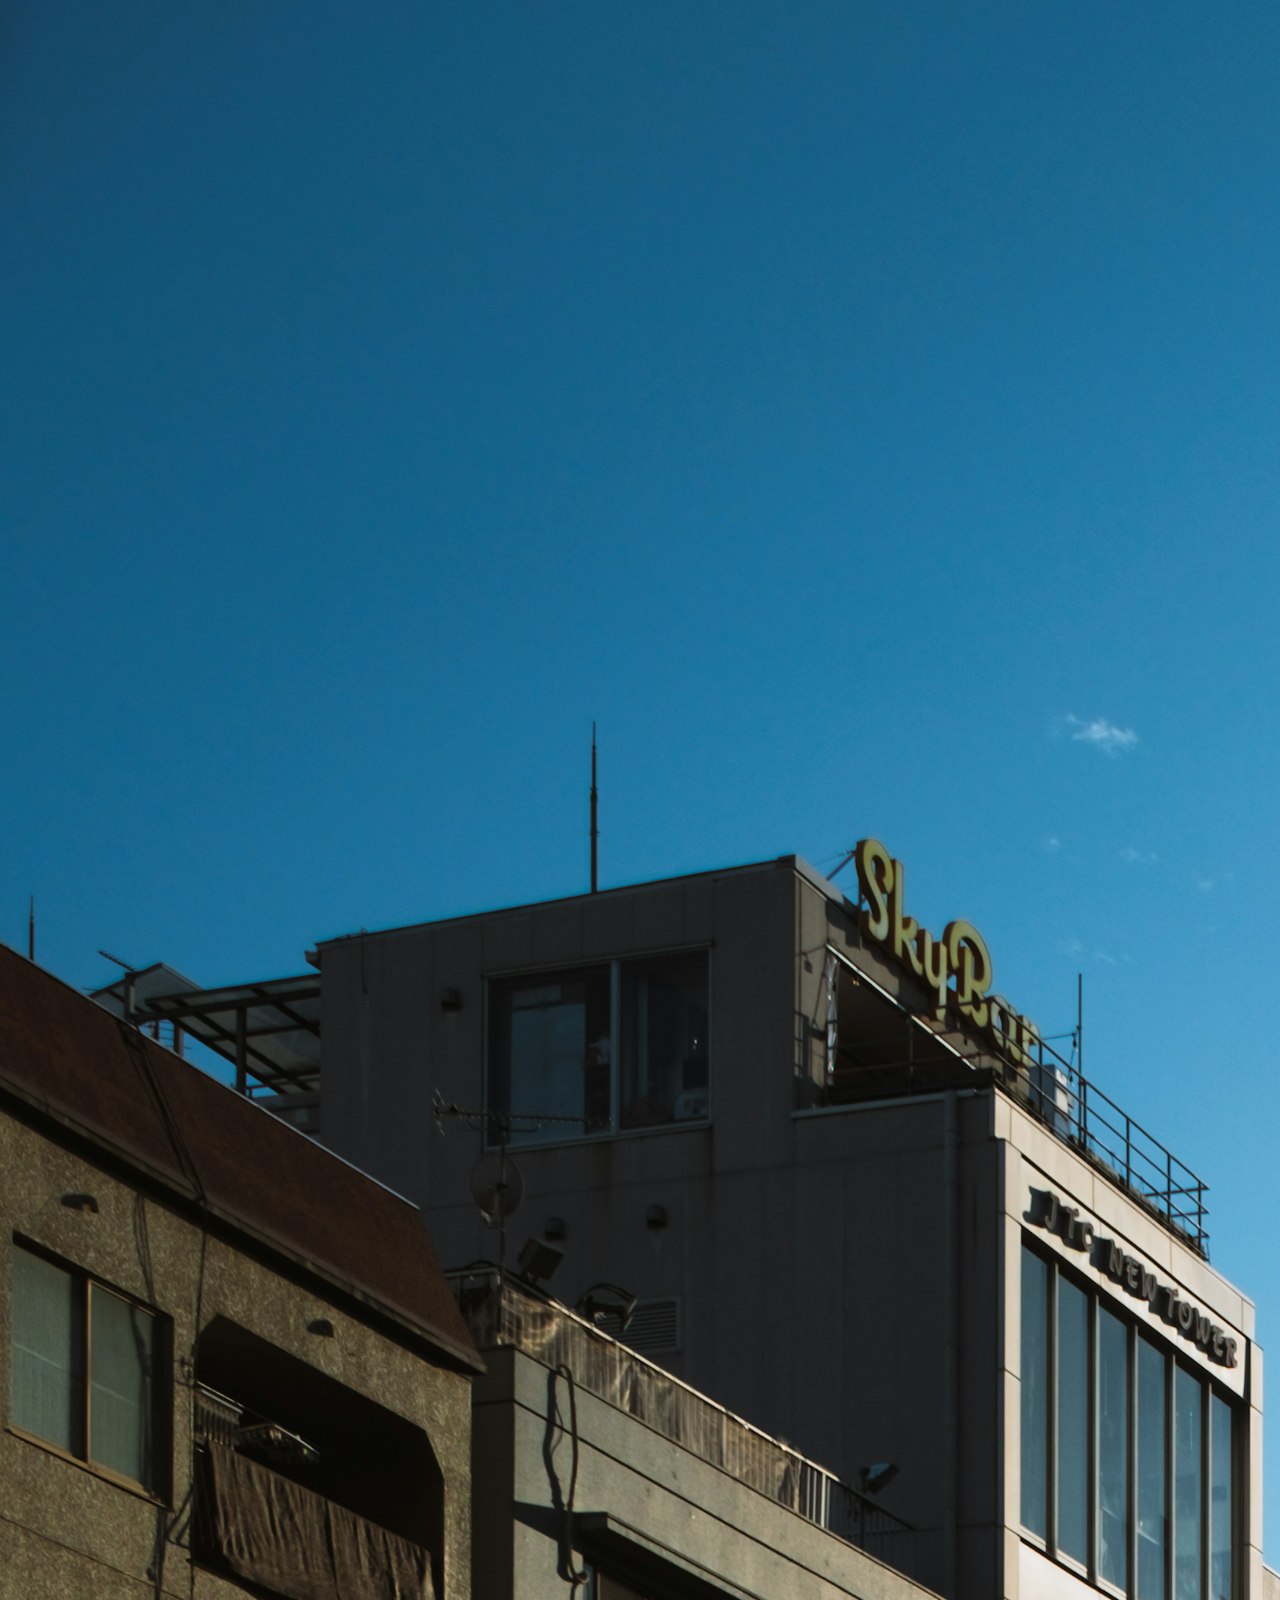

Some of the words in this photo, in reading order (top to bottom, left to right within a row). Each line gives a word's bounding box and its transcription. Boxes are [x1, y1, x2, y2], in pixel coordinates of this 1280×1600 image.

[1040, 1190, 1094, 1254] JTC
[1107, 1239, 1157, 1302] NEW
[1165, 1286, 1238, 1368] TOWER
